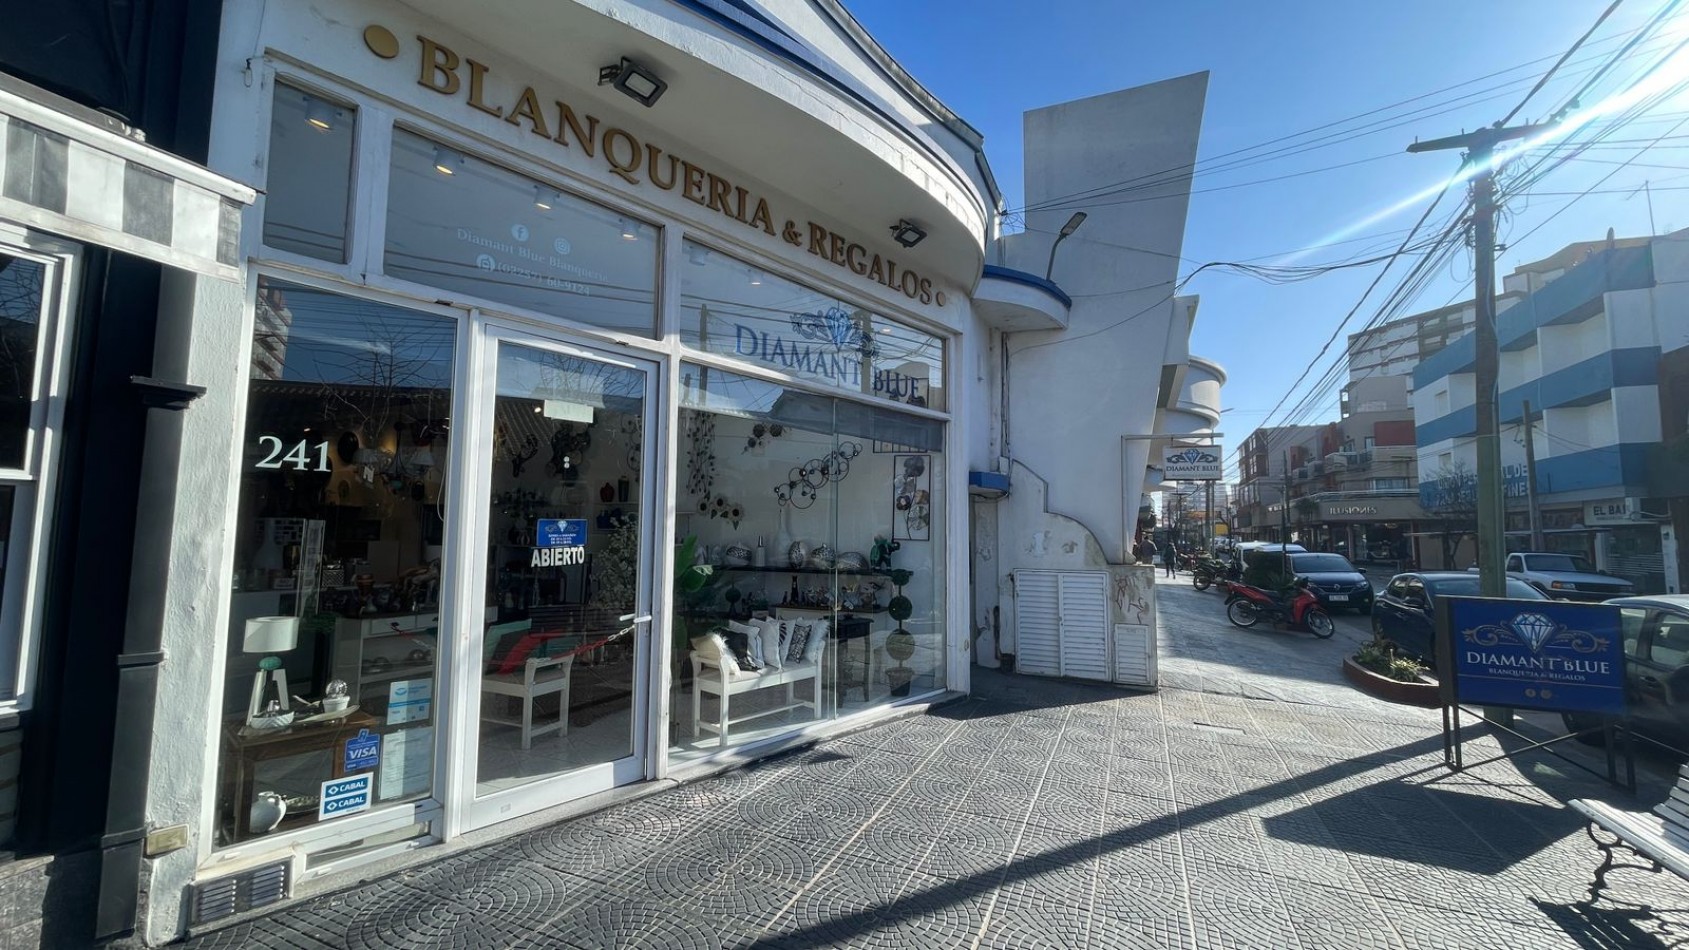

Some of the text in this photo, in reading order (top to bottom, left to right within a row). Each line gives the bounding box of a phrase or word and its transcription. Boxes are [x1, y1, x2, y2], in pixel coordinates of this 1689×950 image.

[417, 34, 933, 305] BLANQUERIA & REGALOS
[457, 228, 513, 254] Diamant
[518, 245, 545, 262] Blue
[734, 322, 920, 400] DIAMANT BLUE
[255, 435, 332, 472] 241
[1329, 506, 1377, 515] ILUSIONES
[1594, 506, 1606, 515] EL
[531, 546, 585, 567] ABIERTO
[1467, 651, 1610, 675] DIAMANT BLUE
[1489, 668, 1539, 678] BLANQUERIA
[1549, 672, 1586, 681] REGALOS
[349, 746, 377, 759] VISA
[340, 780, 365, 792] CABAL
[338, 796, 364, 807] CABAL
